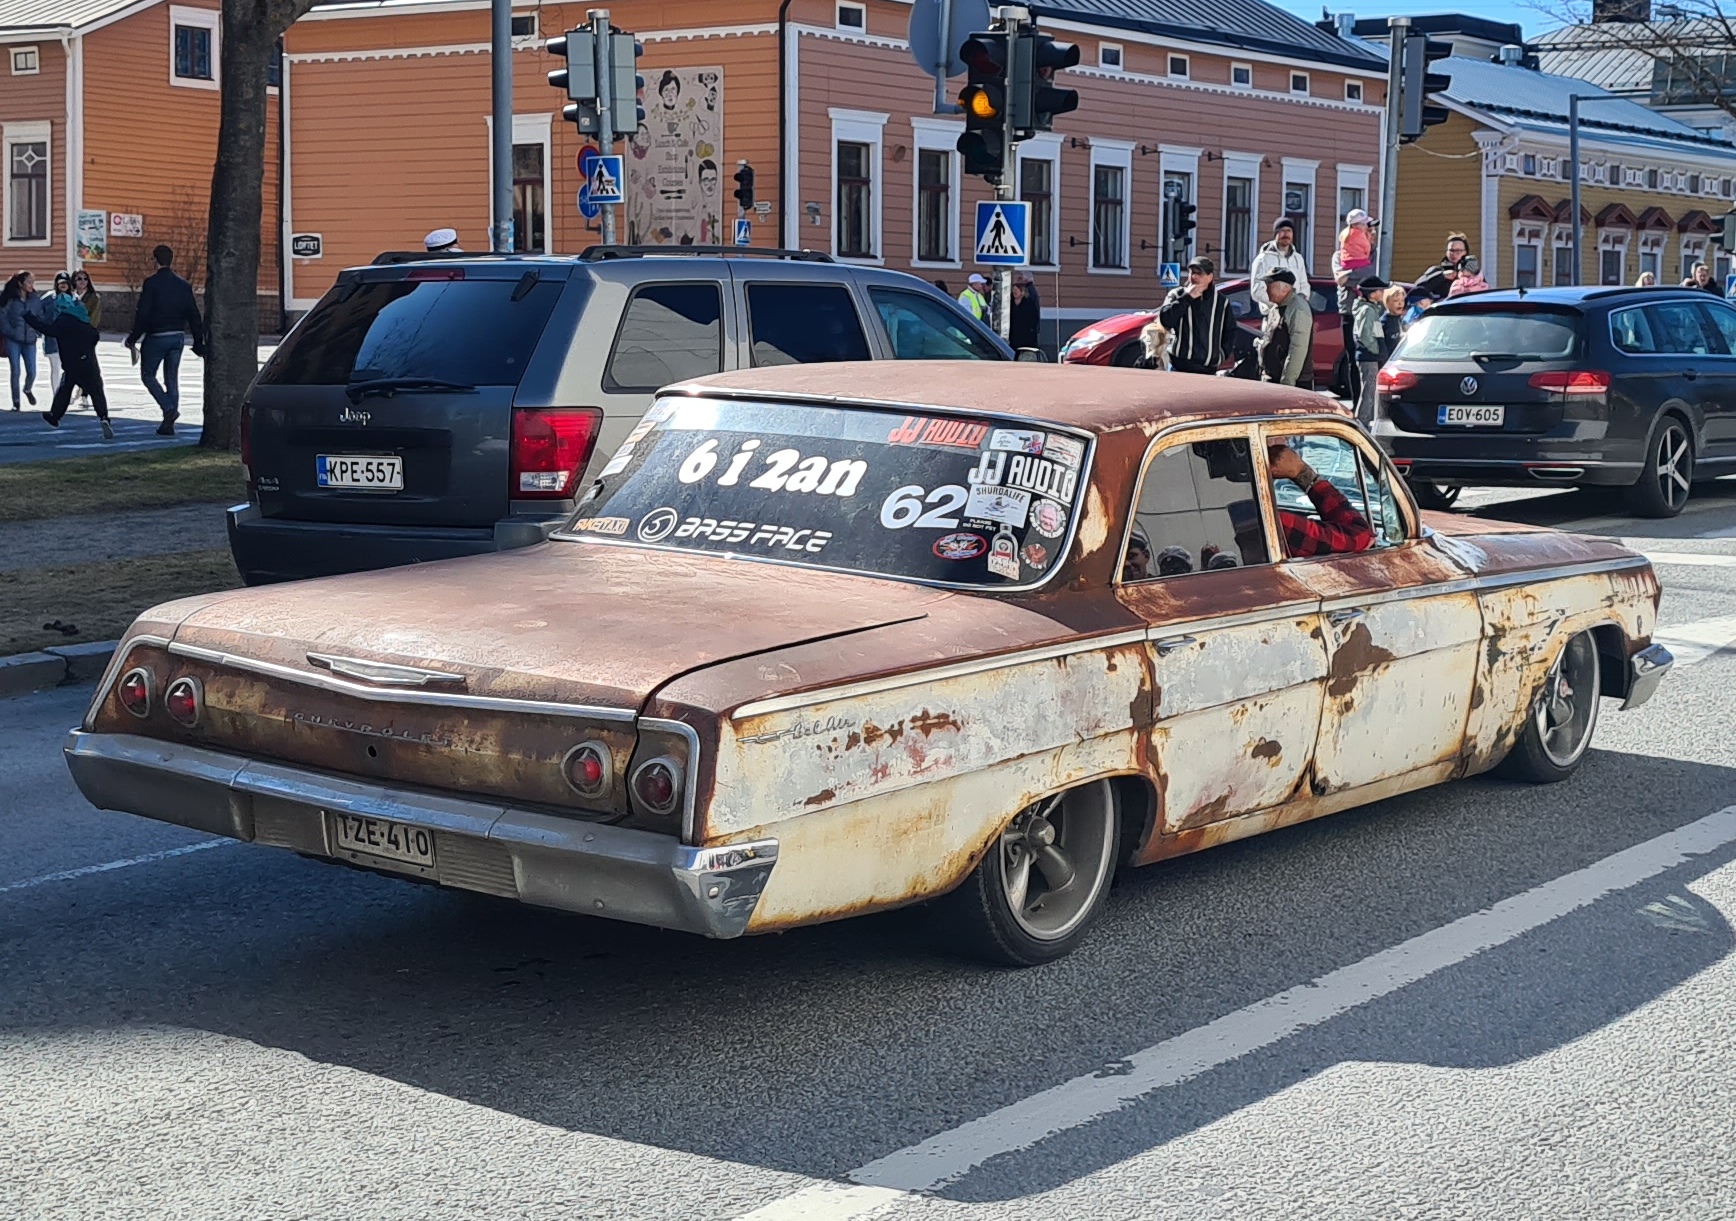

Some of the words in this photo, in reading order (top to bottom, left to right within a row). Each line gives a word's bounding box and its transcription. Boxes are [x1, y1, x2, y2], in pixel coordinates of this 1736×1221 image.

[339, 407, 371, 426] Jeep
[1447, 408, 1500, 422] EOV-605
[888, 416, 928, 444] JJ
[328, 460, 397, 484] KPE-557
[968, 451, 1007, 485] JJ
[1007, 455, 1077, 505] AUDIO
[880, 484, 969, 530] 62
[674, 517, 756, 543] BASS
[750, 525, 833, 552] FACE
